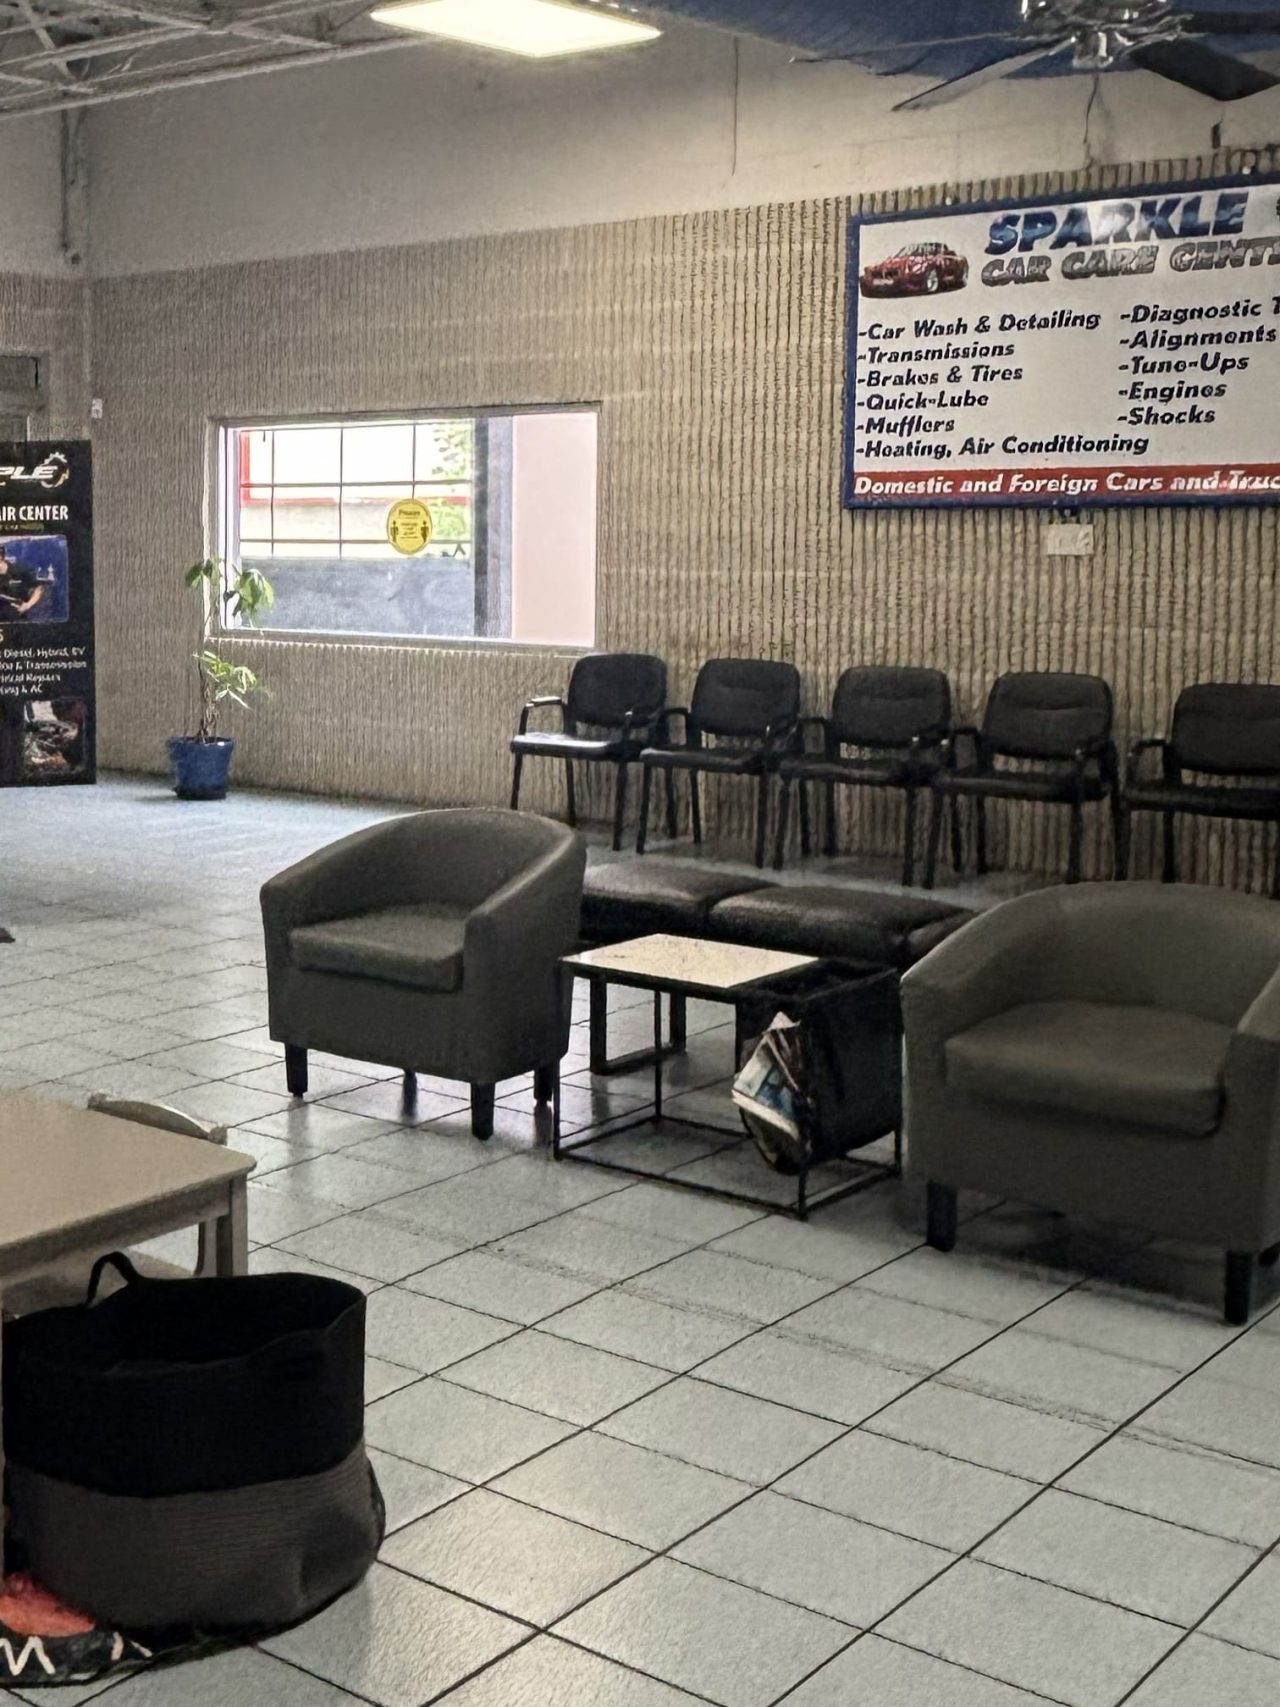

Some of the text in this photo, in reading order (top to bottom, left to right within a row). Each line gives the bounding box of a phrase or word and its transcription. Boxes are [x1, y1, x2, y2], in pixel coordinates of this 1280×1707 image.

[984, 192, 1249, 255] SPARKLE
[981, 236, 1280, 287] CAR CARE CENT
[914, 317, 968, 338] Wash
[975, 315, 991, 333] &
[998, 309, 1102, 331] Detailing
[947, 365, 963, 383] &
[971, 364, 1023, 382] Tires
[958, 436, 995, 455] Air
[1002, 433, 1149, 455] Conditioning
[854, 475, 954, 495] Domestic
[960, 473, 1003, 493] and
[1008, 473, 1098, 495] Foreign
[1106, 471, 1163, 491] Cars
[1228, 469, 1280, 490] Truc
[19, 504, 69, 521] CENTER
